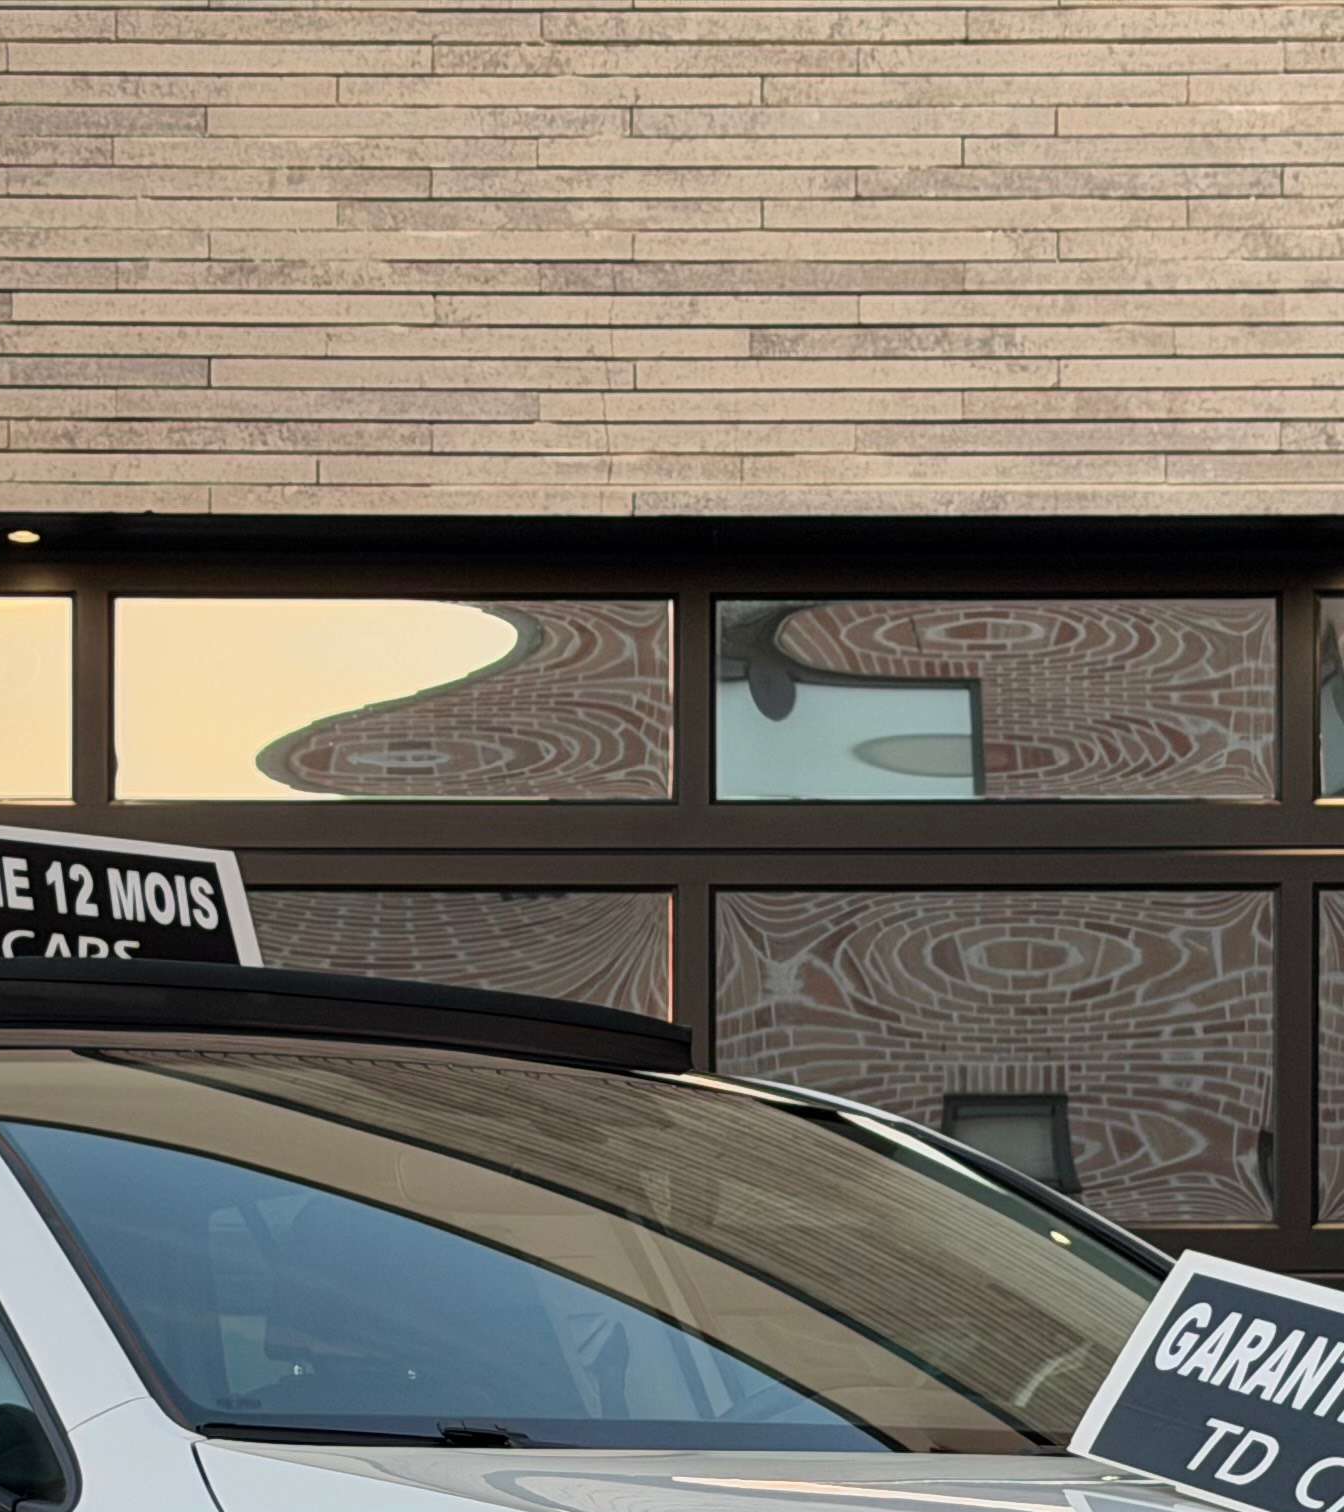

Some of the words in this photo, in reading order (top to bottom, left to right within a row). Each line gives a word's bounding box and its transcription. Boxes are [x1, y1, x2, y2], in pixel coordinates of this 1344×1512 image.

[45, 861, 99, 917] 12
[107, 868, 219, 931] MOIS
[1186, 1418, 1281, 1486] TD
